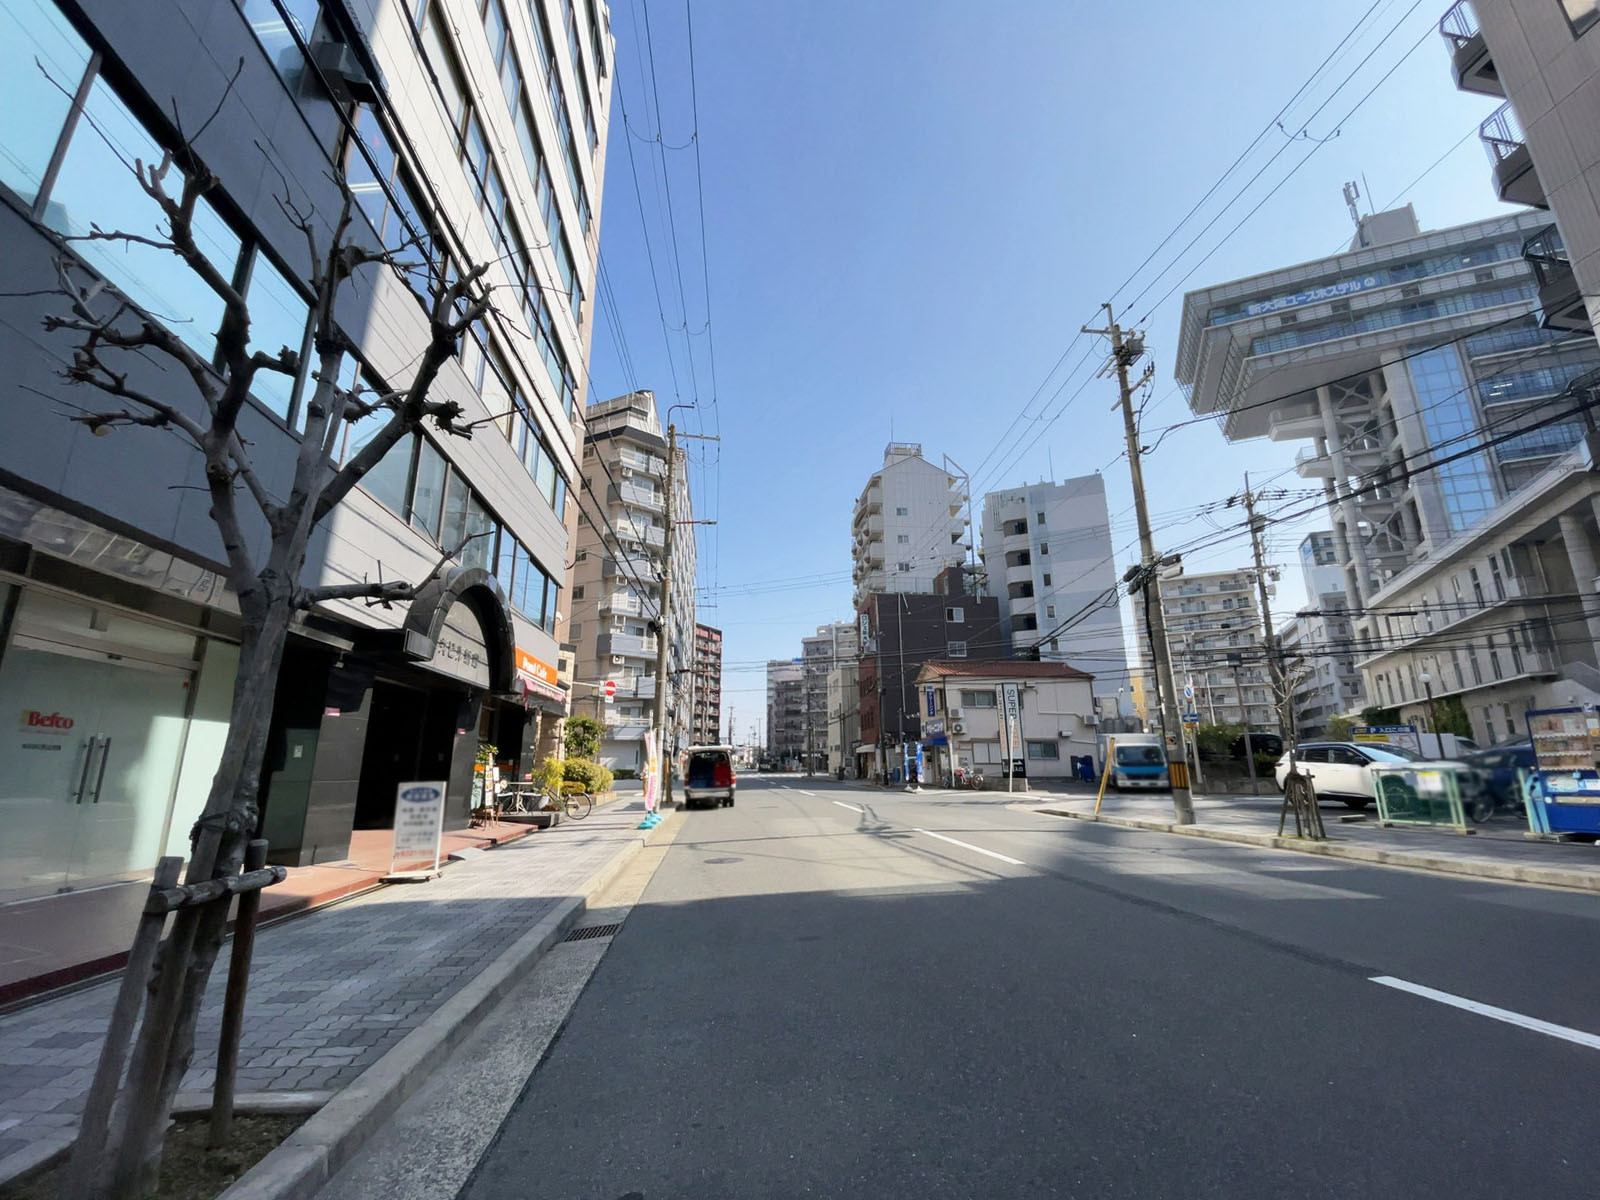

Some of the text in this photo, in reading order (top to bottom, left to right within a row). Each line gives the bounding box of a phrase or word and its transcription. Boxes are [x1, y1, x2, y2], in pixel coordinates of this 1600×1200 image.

[1247, 280, 1361, 316] 新大阪ユースホステル
[1006, 689, 1018, 720] SUPER
